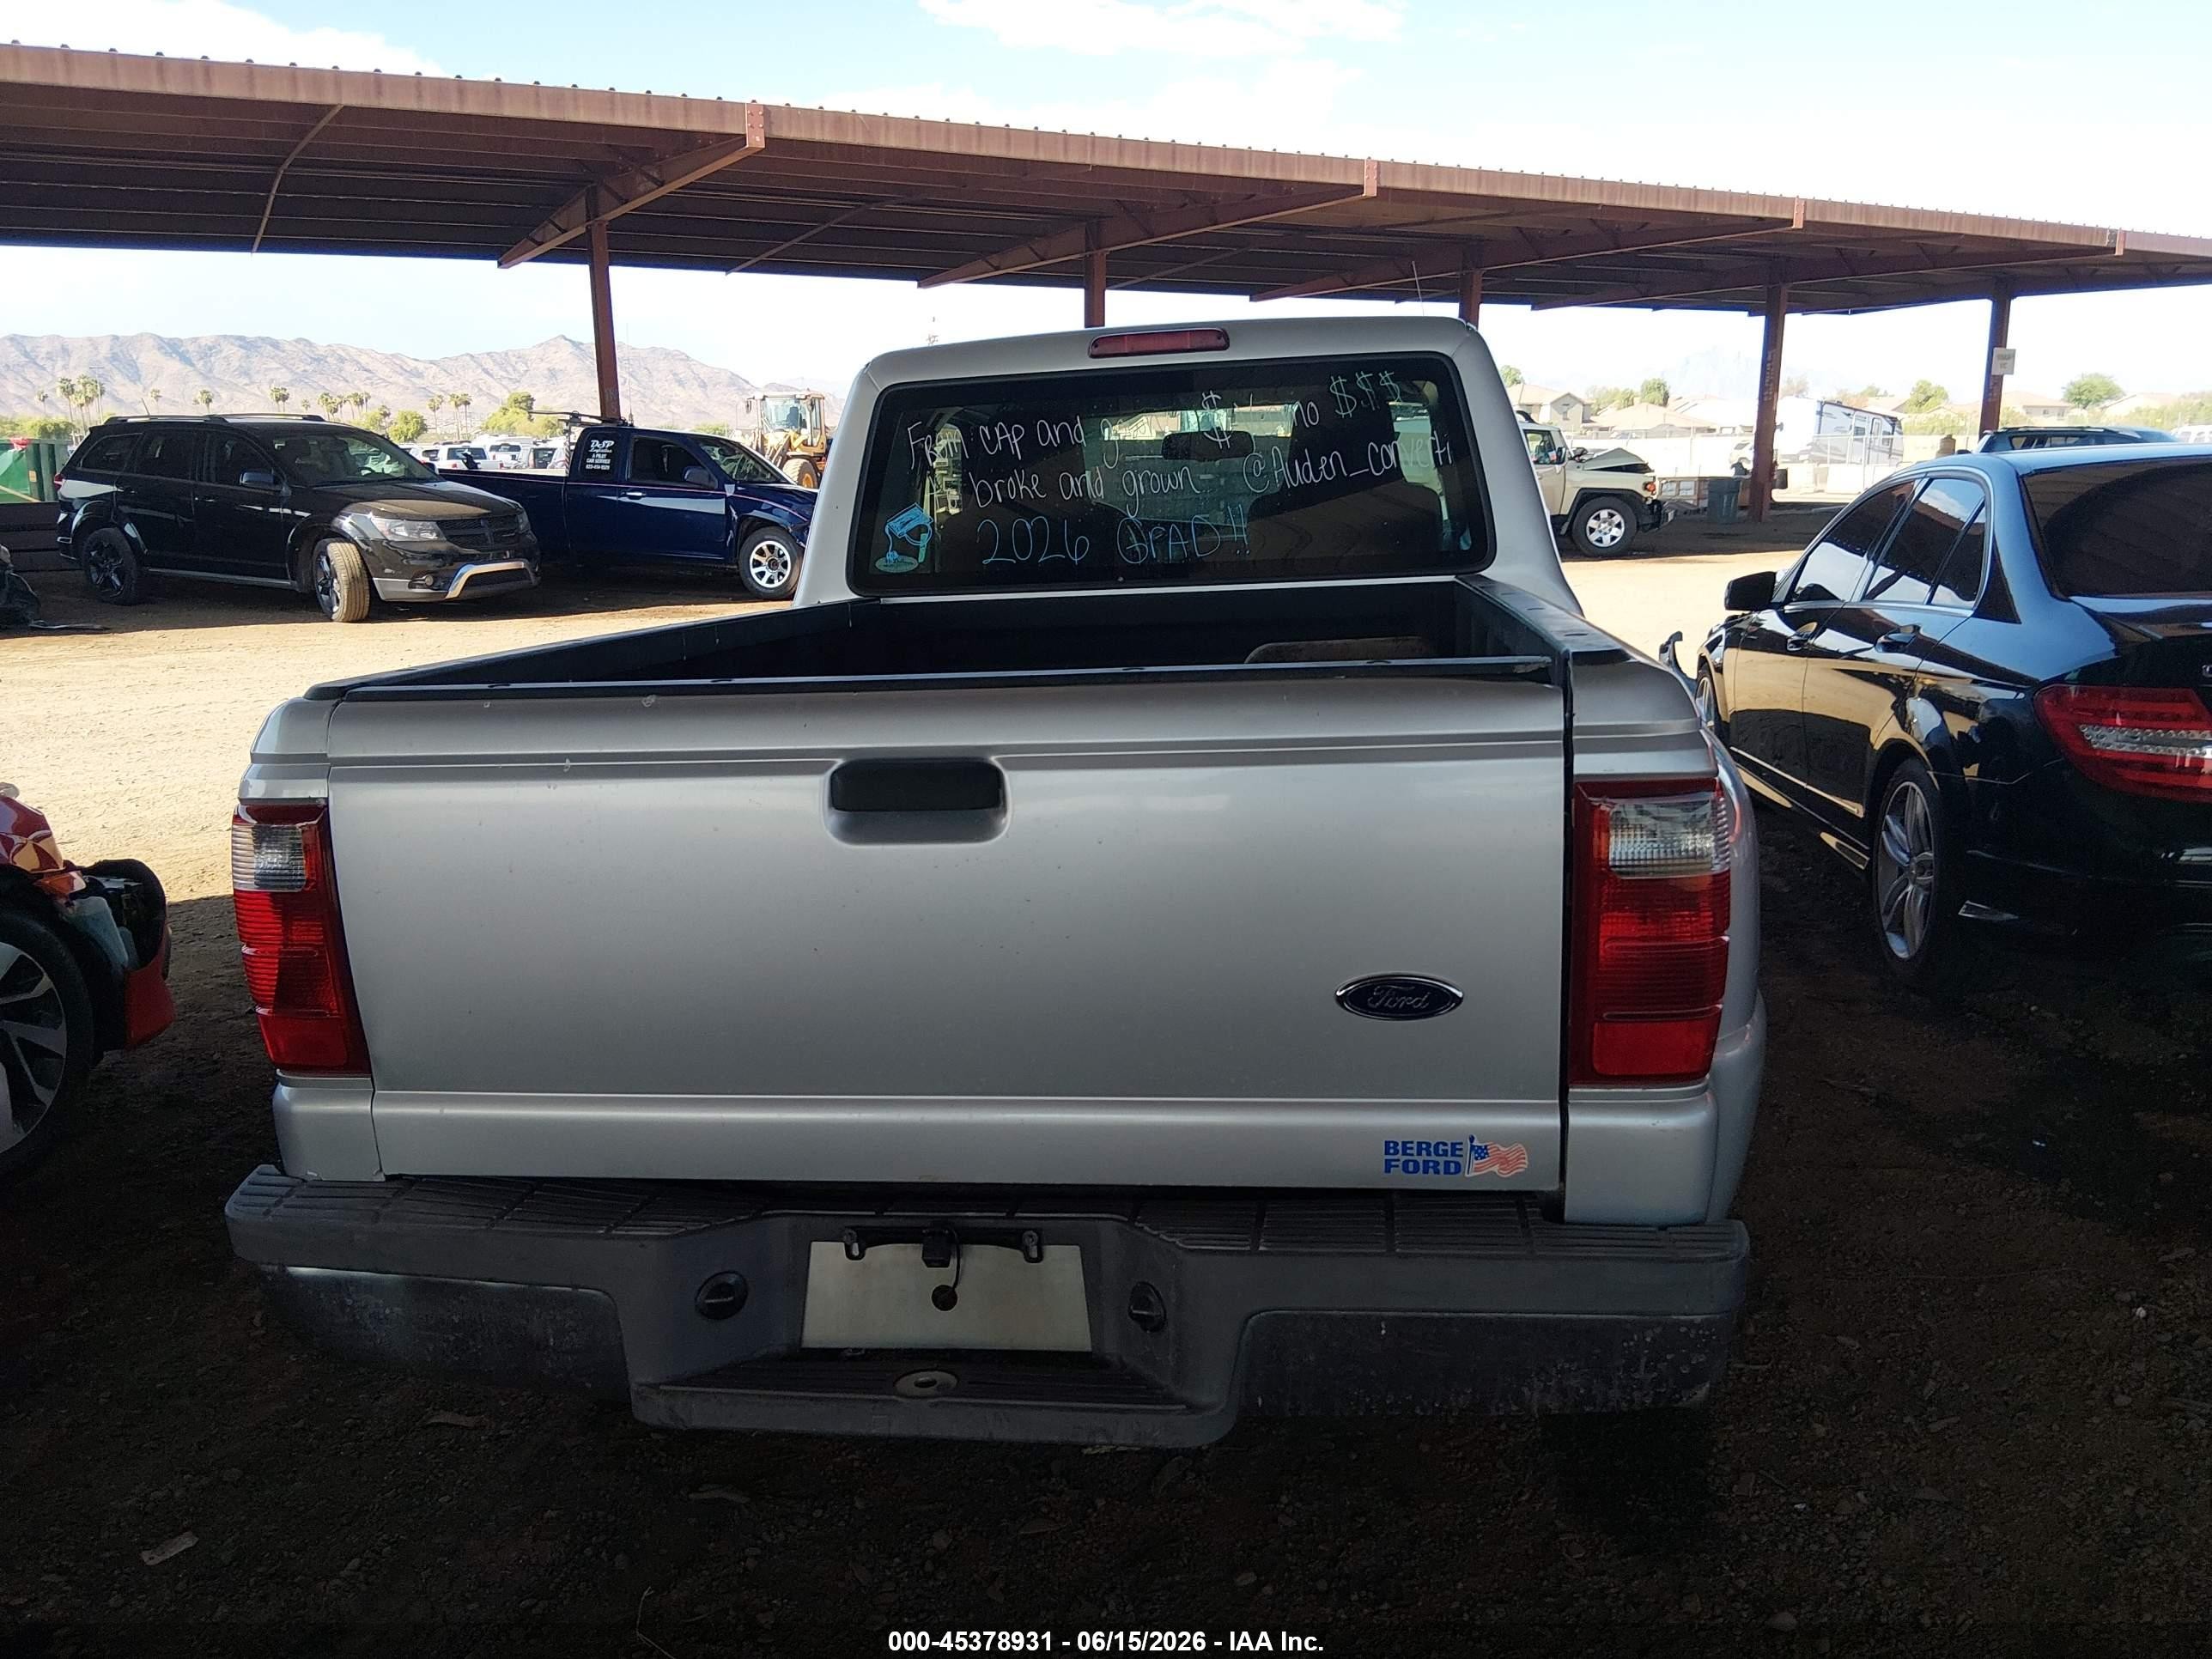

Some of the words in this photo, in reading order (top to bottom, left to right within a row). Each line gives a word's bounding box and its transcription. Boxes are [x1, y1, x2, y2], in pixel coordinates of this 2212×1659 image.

[1036, 415, 1087, 447] and
[1058, 465, 1104, 501] and
[975, 515, 1091, 566] 2026
[1367, 984, 1431, 1010] Ford
[1383, 1139, 1464, 1158] BERGE
[1383, 1158, 1462, 1176] FORD
